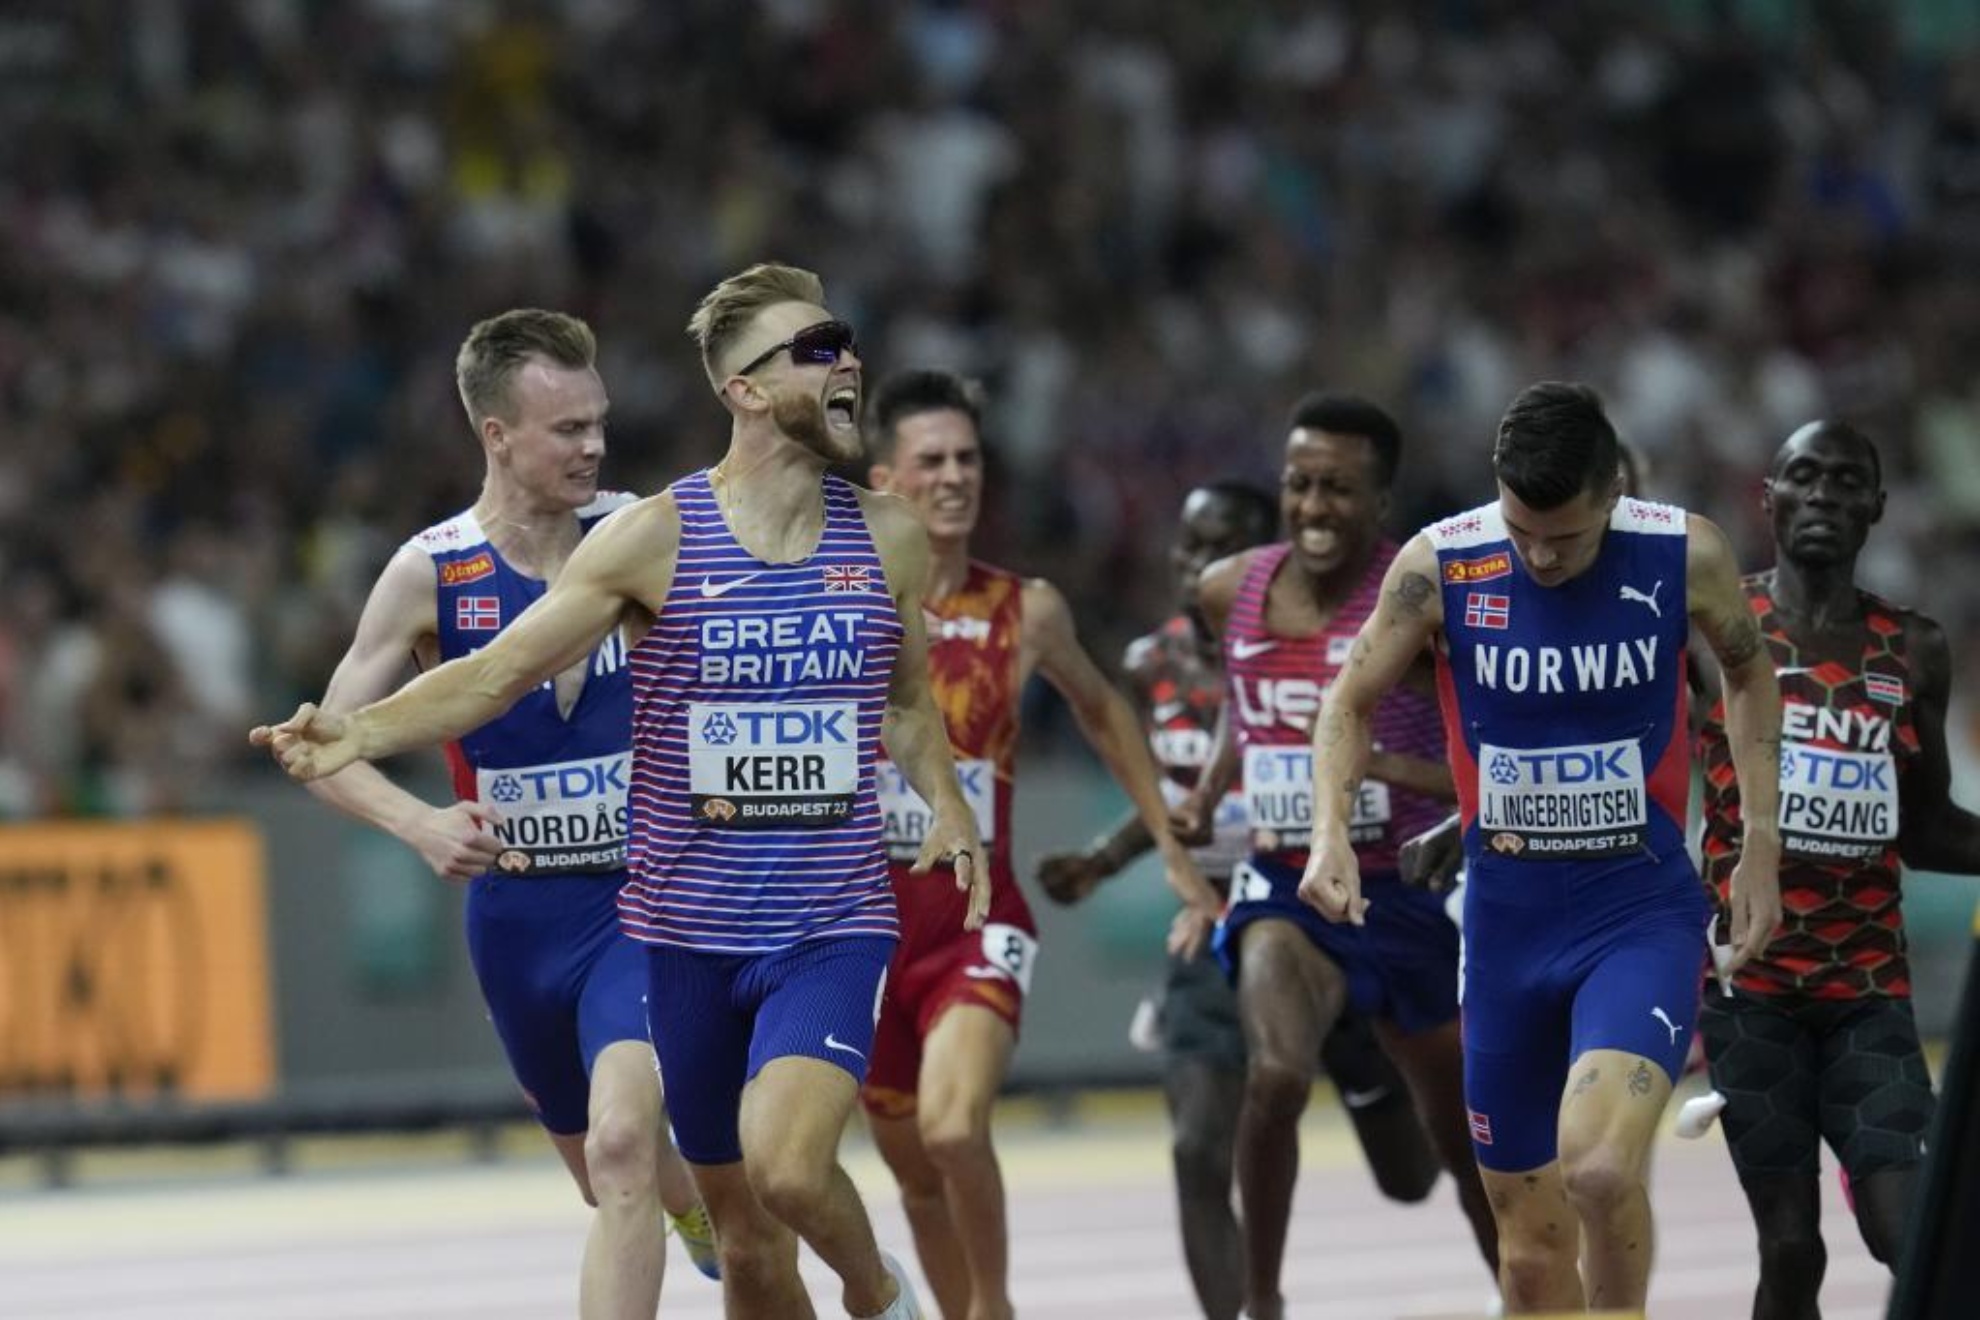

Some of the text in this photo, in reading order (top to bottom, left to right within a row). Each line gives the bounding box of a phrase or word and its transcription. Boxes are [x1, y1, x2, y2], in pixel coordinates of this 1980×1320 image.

[1468, 559, 1508, 577] EXTRA
[702, 613, 864, 650] GREAT
[701, 650, 865, 683] BRITAIN
[1474, 635, 1658, 693] NORWAY
[1233, 676, 1326, 729] US
[736, 710, 848, 744] TDK
[1781, 702, 1891, 751] ENYA
[520, 759, 627, 800] TDK
[725, 754, 826, 792] KERR
[1517, 747, 1631, 784] TDK
[1799, 751, 1889, 792] TDK
[493, 802, 628, 846] NORDÅS
[742, 802, 831, 816] BUDAPEST
[1484, 788, 1639, 827] J. INGEBRIGTSEN
[1779, 790, 1888, 836] PSANG
[535, 849, 618, 868] BUDAPEST
[1528, 833, 1639, 851] BUDAPEST 23
